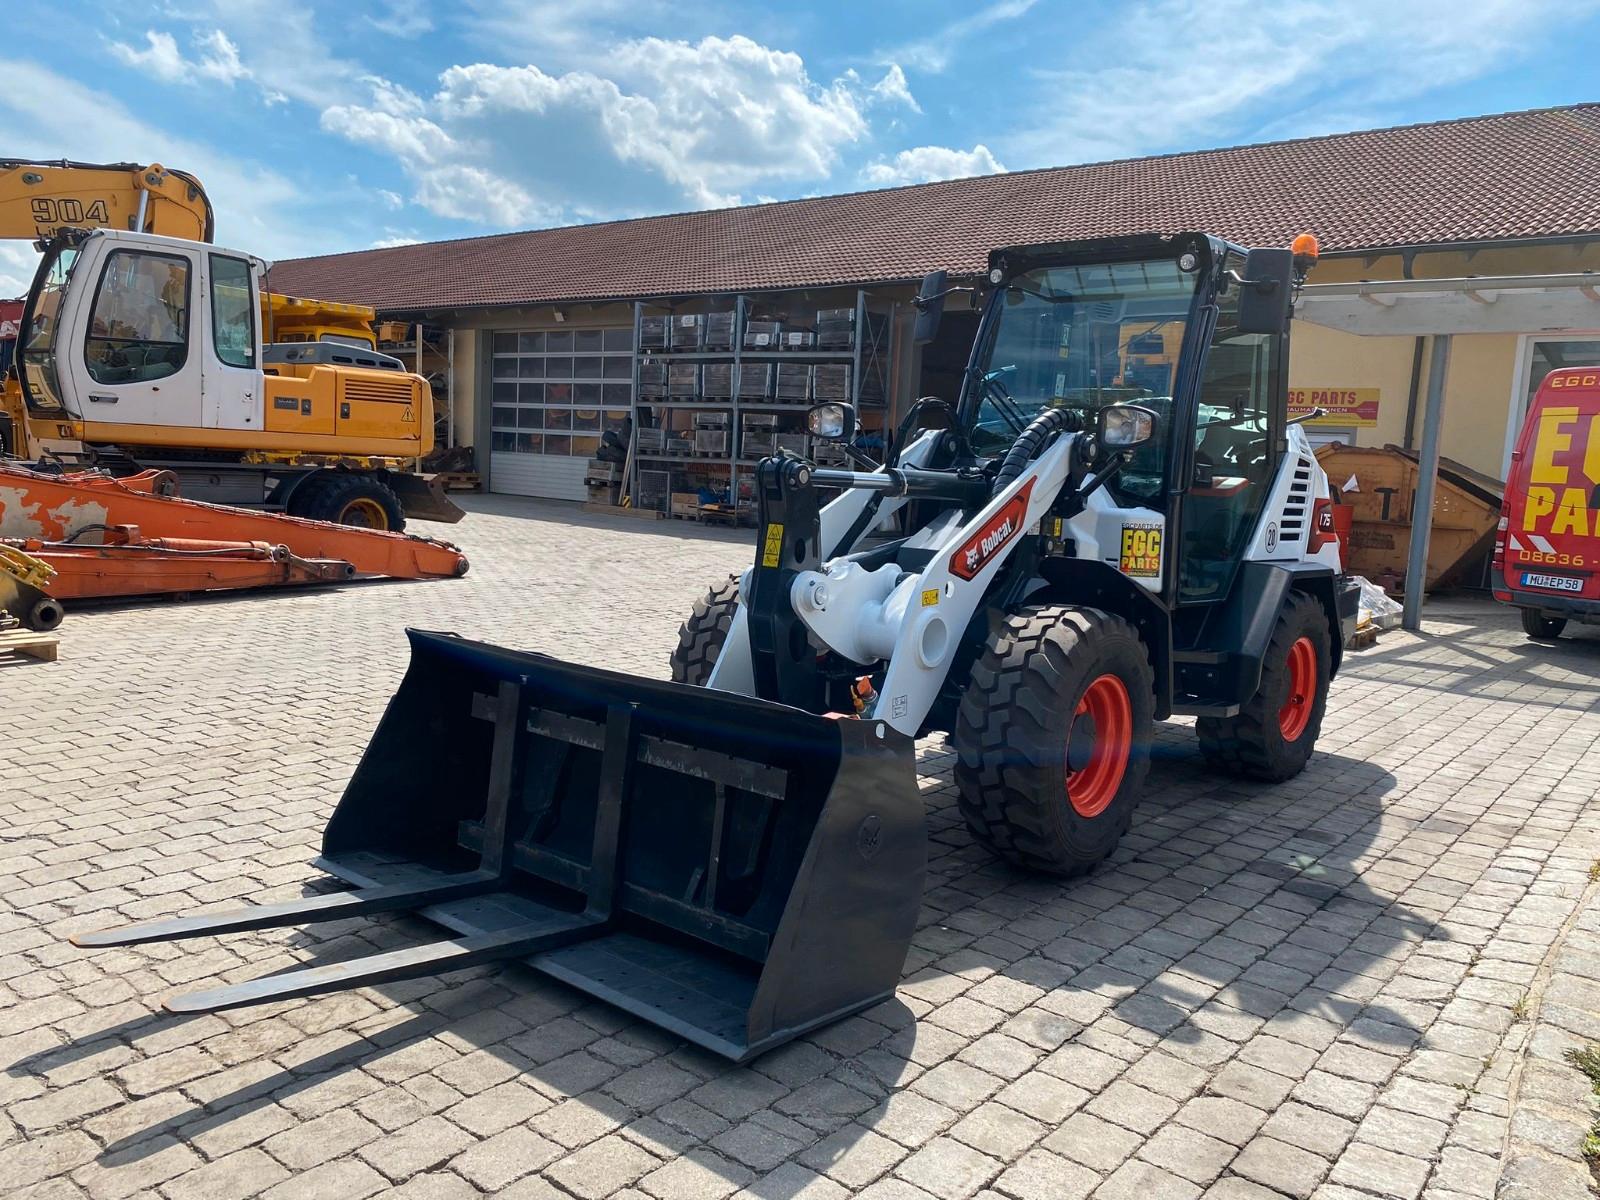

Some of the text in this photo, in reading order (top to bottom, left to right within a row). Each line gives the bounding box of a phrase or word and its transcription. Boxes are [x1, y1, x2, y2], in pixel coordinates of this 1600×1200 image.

[31, 198, 109, 223] 904
[1551, 375, 1600, 388] EGC
[1311, 391, 1357, 405] PARTS
[1522, 486, 1600, 537] PA
[981, 517, 1012, 558] Bobcat
[1122, 529, 1161, 558] EGC
[1267, 528, 1276, 547] 20
[1121, 556, 1159, 570] PARTS
[1520, 550, 1584, 566] 08636
[1530, 575, 1579, 590] MÜ EP 58
